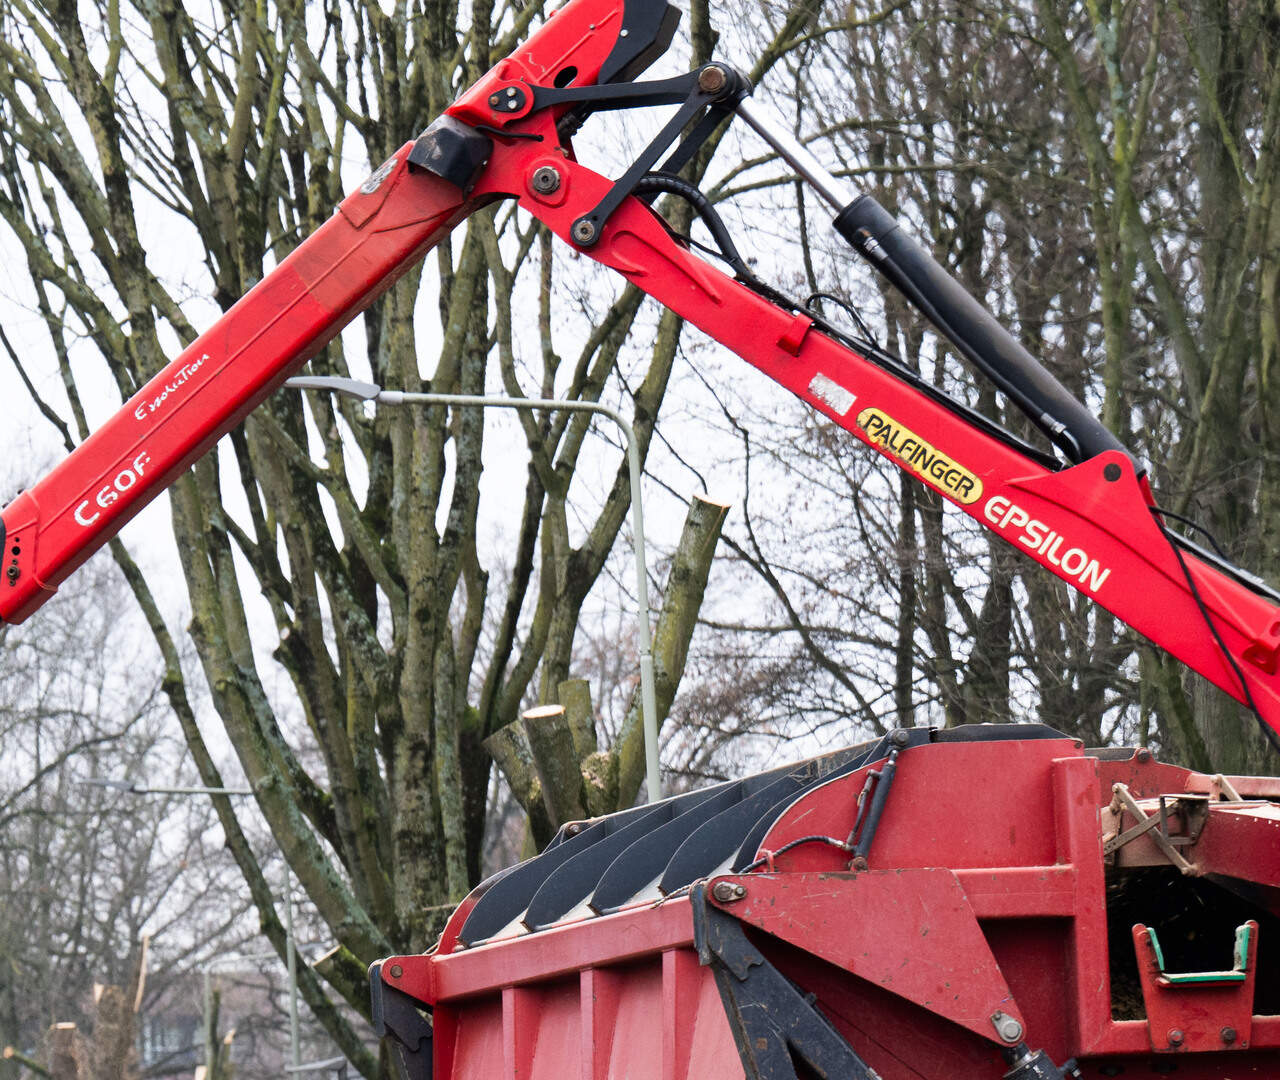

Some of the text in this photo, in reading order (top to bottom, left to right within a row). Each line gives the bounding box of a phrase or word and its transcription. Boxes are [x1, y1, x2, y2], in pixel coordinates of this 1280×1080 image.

[74, 451, 151, 527] C60F
[863, 414, 975, 498] PALFINGER
[983, 495, 1111, 592] EPSILON
